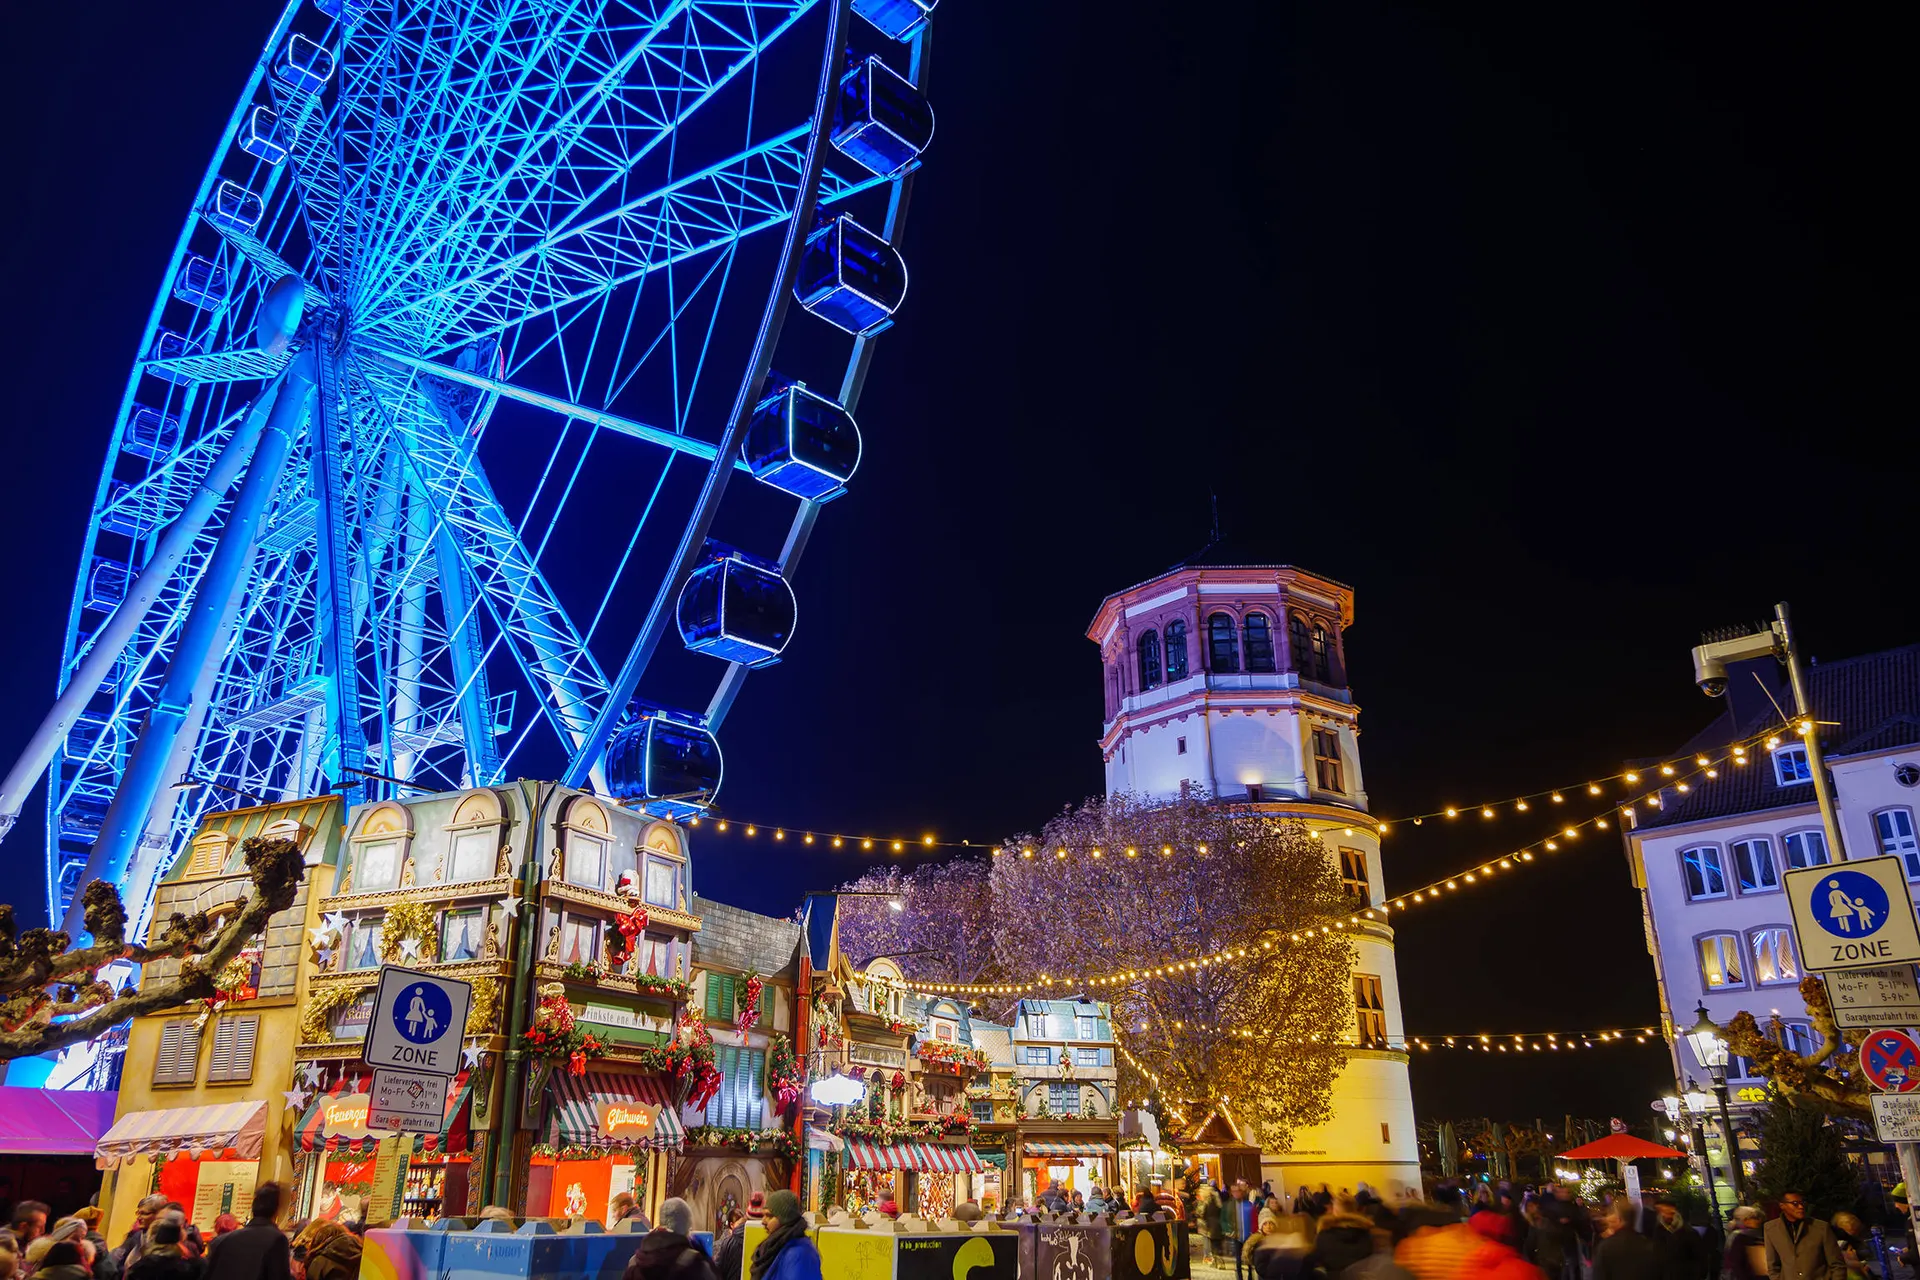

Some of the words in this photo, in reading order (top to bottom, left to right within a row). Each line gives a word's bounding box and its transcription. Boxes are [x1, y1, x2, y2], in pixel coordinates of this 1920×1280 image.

[1830, 940, 1892, 962] ZONE
[1837, 969, 1888, 980] Lieferverkehr
[1837, 981, 1869, 992] Mo-Fr
[1841, 994, 1855, 1004] Sa
[1844, 1011, 1903, 1023] Garagenzufahrt
[1904, 1011, 1919, 1021] frei
[391, 1045, 438, 1066] ZONE
[426, 1080, 438, 1089] frei
[380, 1086, 405, 1096] Mo-Fr
[379, 1097, 390, 1106] Sa
[423, 1119, 435, 1128] frei
[607, 1108, 649, 1132] Glühwein
